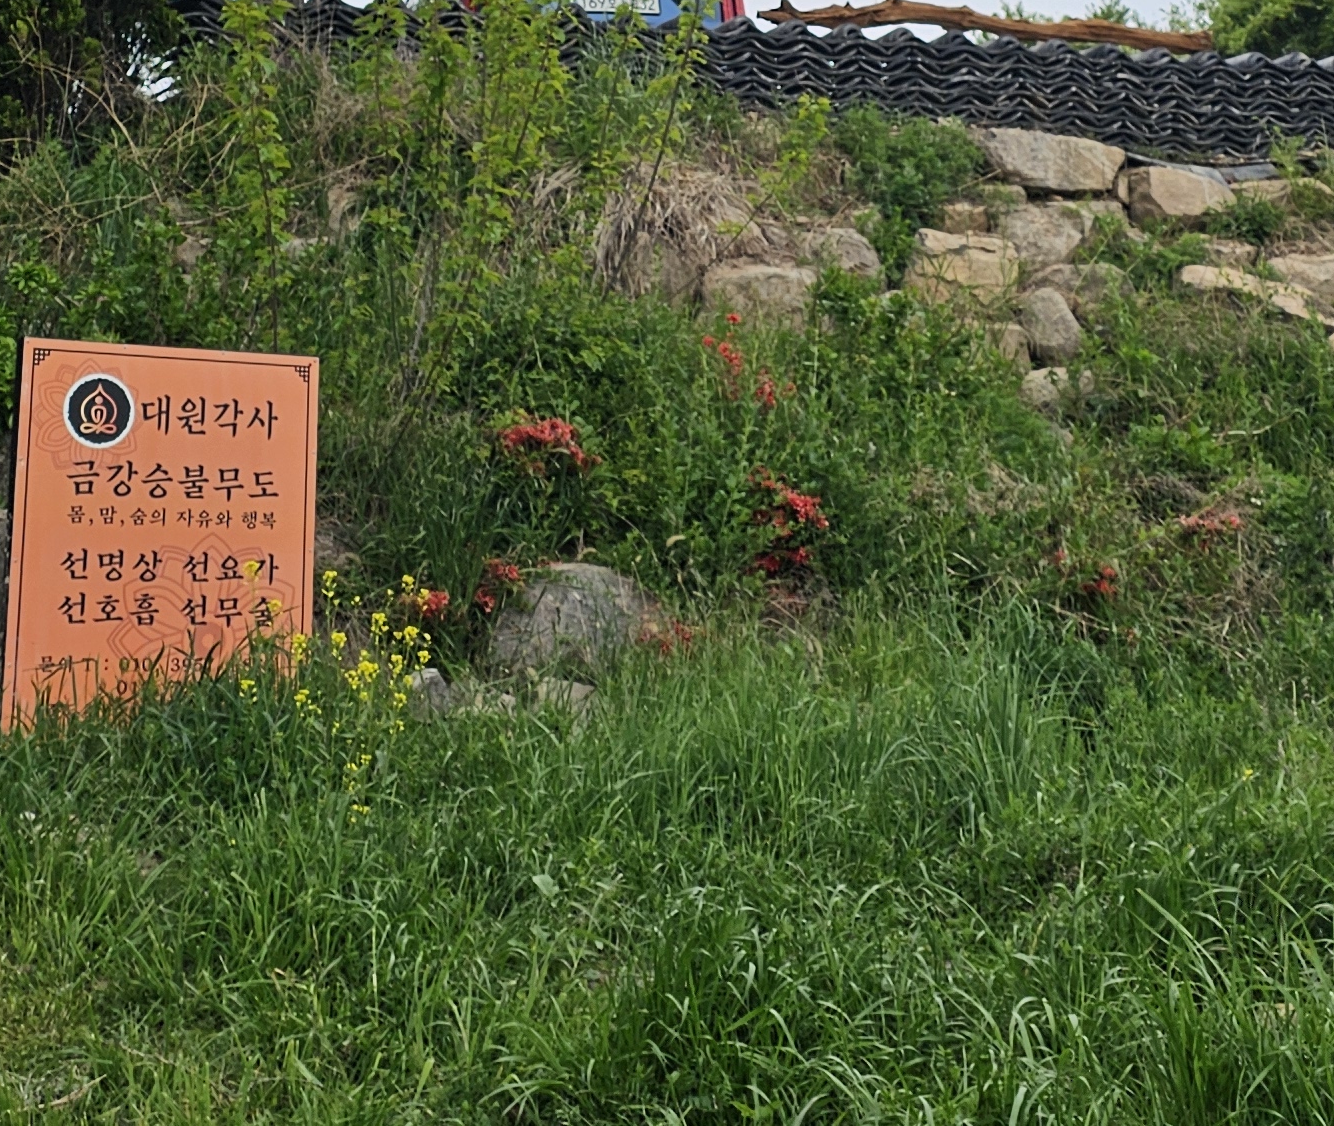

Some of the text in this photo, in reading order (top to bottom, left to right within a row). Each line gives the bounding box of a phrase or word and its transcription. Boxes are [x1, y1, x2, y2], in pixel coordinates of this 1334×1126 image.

[140, 394, 279, 440] 대원각사
[66, 460, 280, 502] 금강승불무도
[176, 508, 233, 529] 자유와
[241, 510, 277, 530] 행복
[60, 548, 279, 586] 선명상 선요가
[57, 592, 278, 628] 선호흡 선무술
